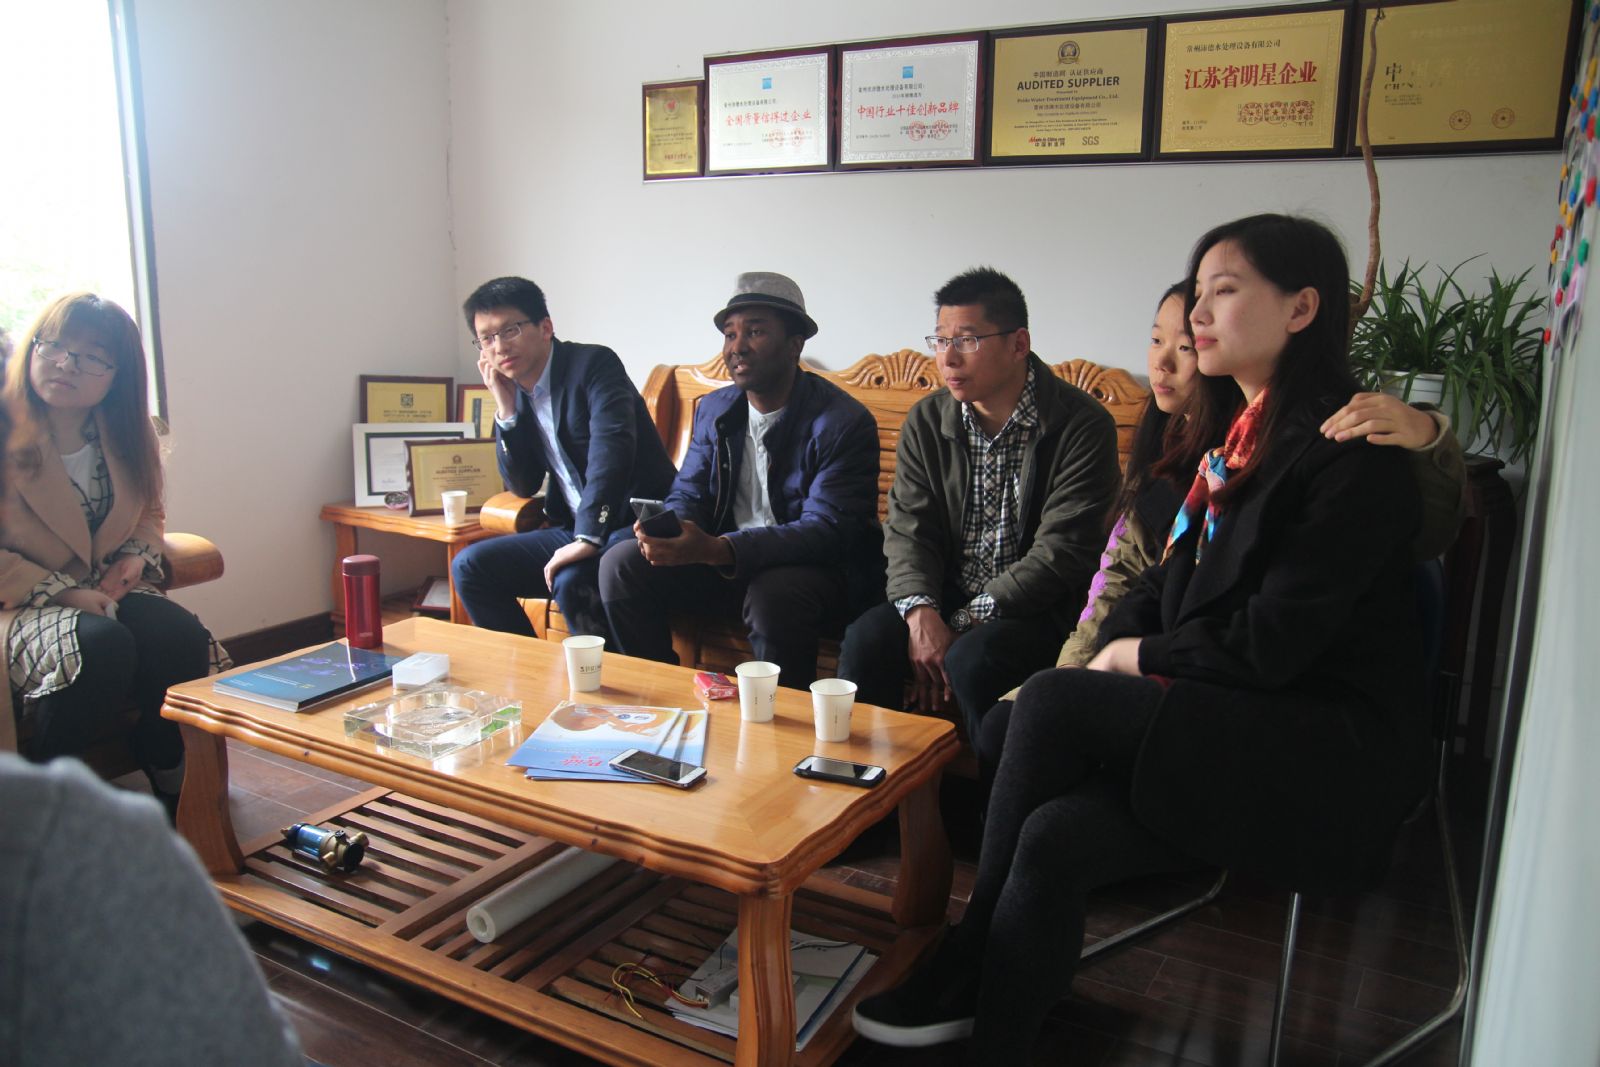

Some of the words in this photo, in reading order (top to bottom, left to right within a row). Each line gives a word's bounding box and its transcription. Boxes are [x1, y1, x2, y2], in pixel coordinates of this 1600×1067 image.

[1017, 79, 1064, 90] AUDITED
[1067, 76, 1120, 88] SUPPLIER
[1184, 61, 1317, 90] 江苏省明星企业
[857, 101, 960, 119] 中国行业十佳创新品牌
[1081, 136, 1100, 146] SGS
